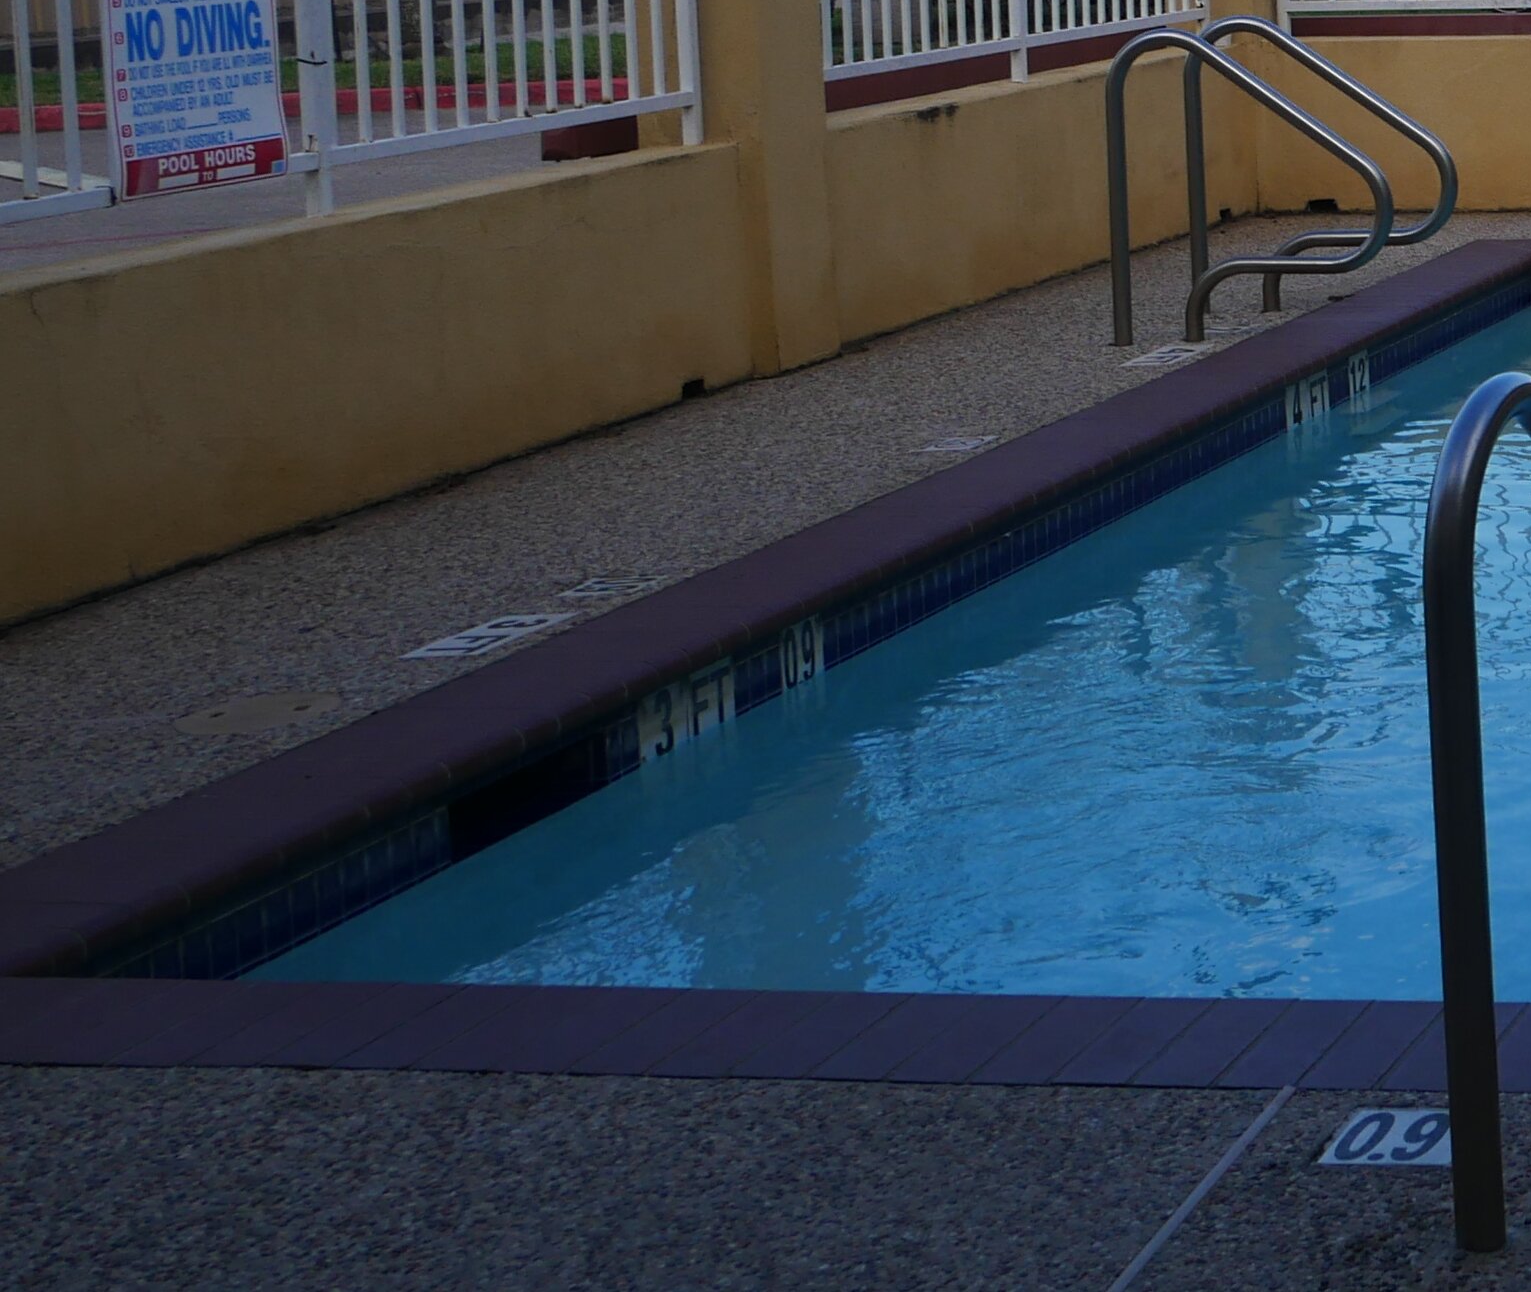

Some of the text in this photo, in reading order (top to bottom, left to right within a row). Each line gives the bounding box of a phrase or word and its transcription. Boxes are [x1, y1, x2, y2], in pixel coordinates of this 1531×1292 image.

[125, 8, 166, 63] NO
[225, 74, 240, 89] OLD
[157, 153, 200, 176] POOL
[203, 144, 257, 169] HOURS
[202, 171, 214, 182] TO
[1293, 376, 1325, 424] 4 FT
[425, 619, 549, 653] 3 FT
[655, 665, 731, 756] 3 FT
[1334, 1112, 1449, 1162] 0.9
